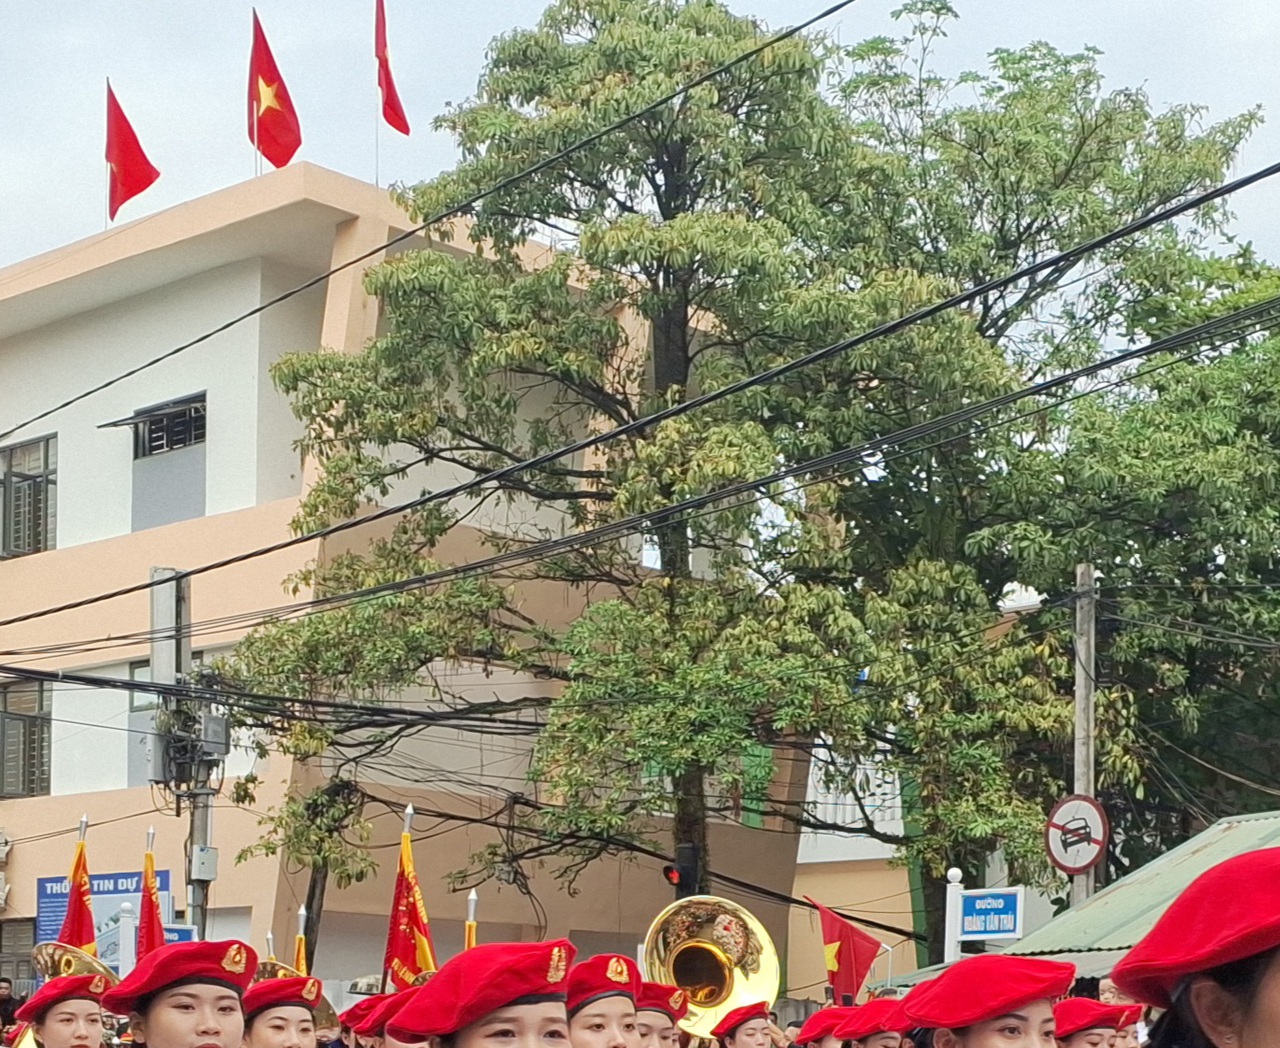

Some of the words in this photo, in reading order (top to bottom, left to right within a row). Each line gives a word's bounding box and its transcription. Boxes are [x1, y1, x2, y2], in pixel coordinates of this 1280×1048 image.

[45, 880, 70, 894] THÔ
[92, 880, 113, 891] TIN
[118, 877, 139, 892] DỰ
